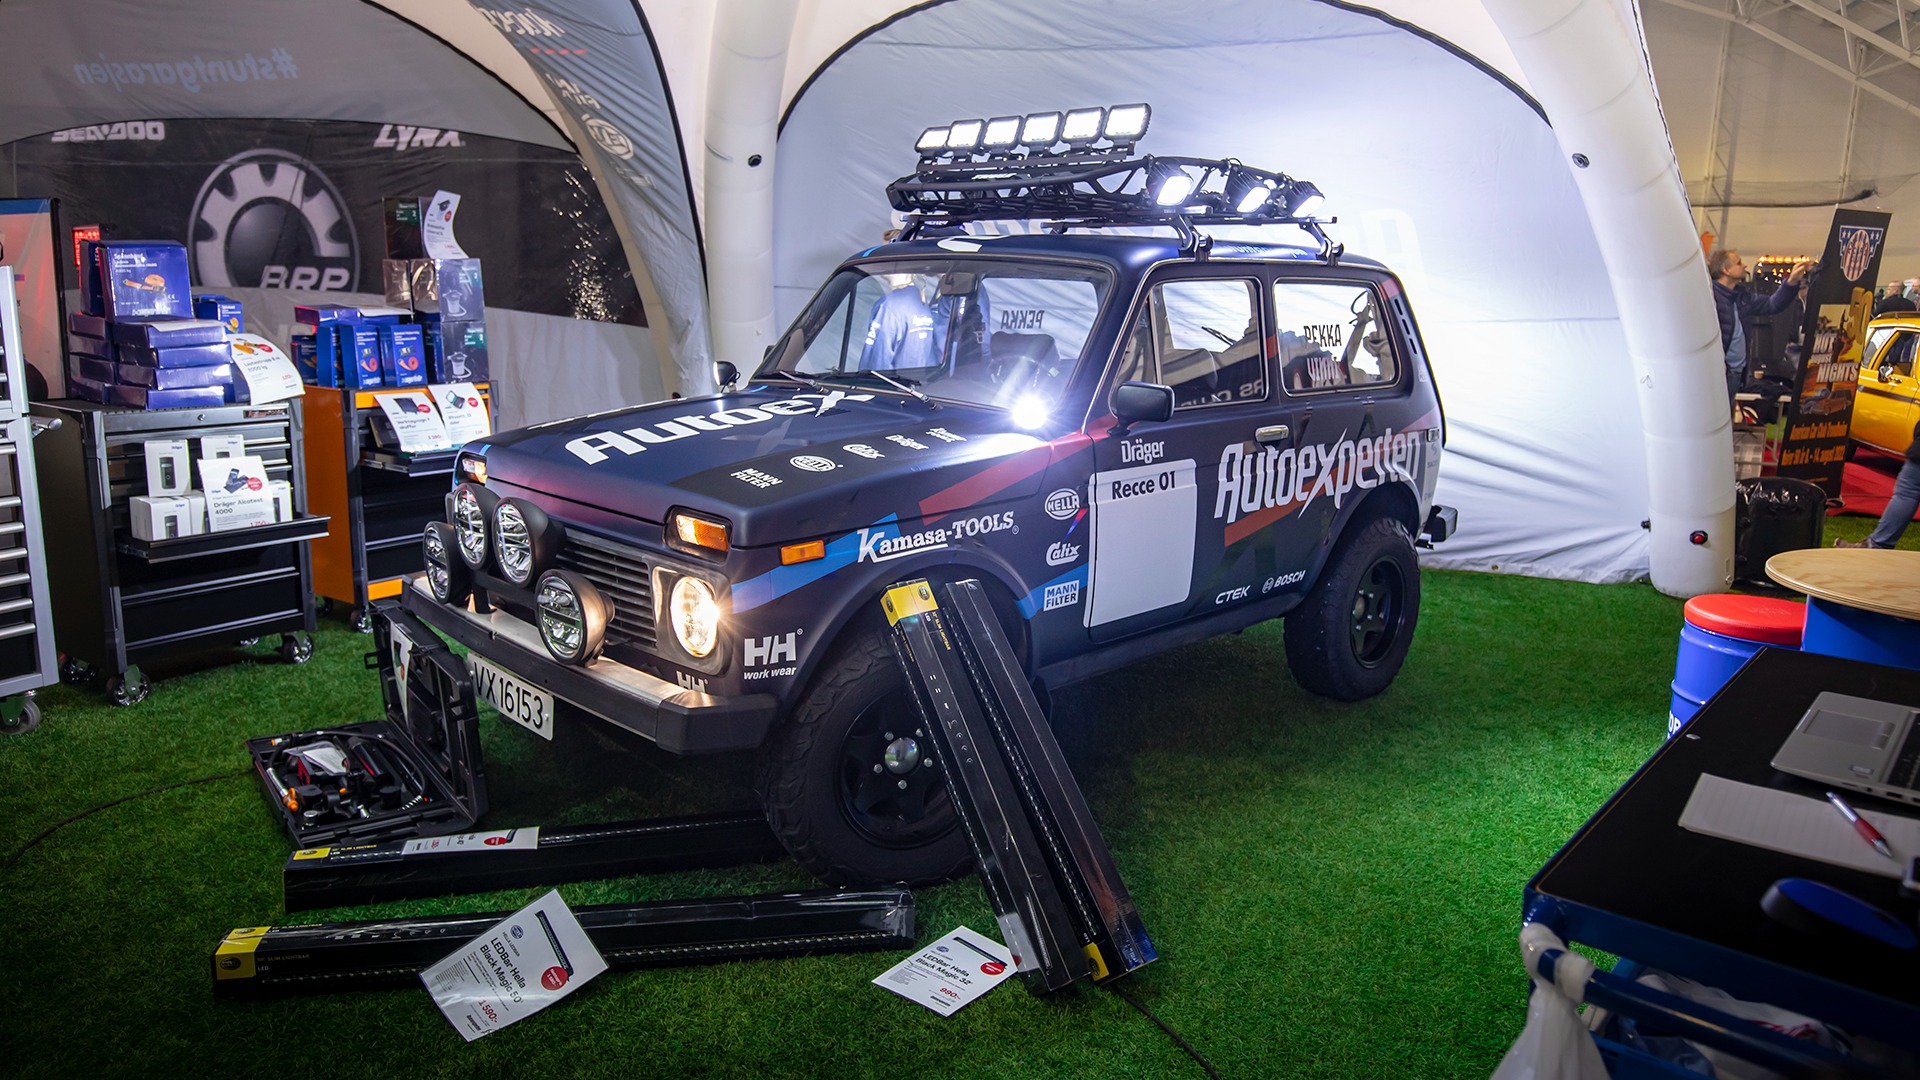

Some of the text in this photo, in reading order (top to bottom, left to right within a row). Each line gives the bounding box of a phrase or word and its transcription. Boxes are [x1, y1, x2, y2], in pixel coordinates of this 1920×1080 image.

[260, 266, 350, 292] BRP
[1816, 363, 1859, 382] NIGHTS
[1121, 440, 1165, 464] Dräger
[730, 472, 771, 488] FILTER
[743, 468, 783, 485] MANN
[1112, 470, 1176, 500] Recce 01
[1046, 494, 1080, 512] HELLA
[857, 511, 1015, 563] Kamasa-TOOLS
[1046, 542, 1081, 566] Calix
[1046, 583, 1078, 598] MANN
[1274, 570, 1306, 588] BOSCH
[1046, 592, 1077, 608] FILTER
[1216, 585, 1250, 605] CTEK
[744, 632, 796, 667] HH
[744, 666, 797, 680] work wear
[474, 662, 544, 730] VX 16153
[479, 944, 499, 971] Black
[494, 966, 514, 995] Magic
[490, 936, 526, 989] LEDBar Hella
[916, 958, 938, 971] Black
[938, 966, 959, 980] Magic
[922, 953, 950, 969] LEDBar
[950, 965, 970, 978] Hella
